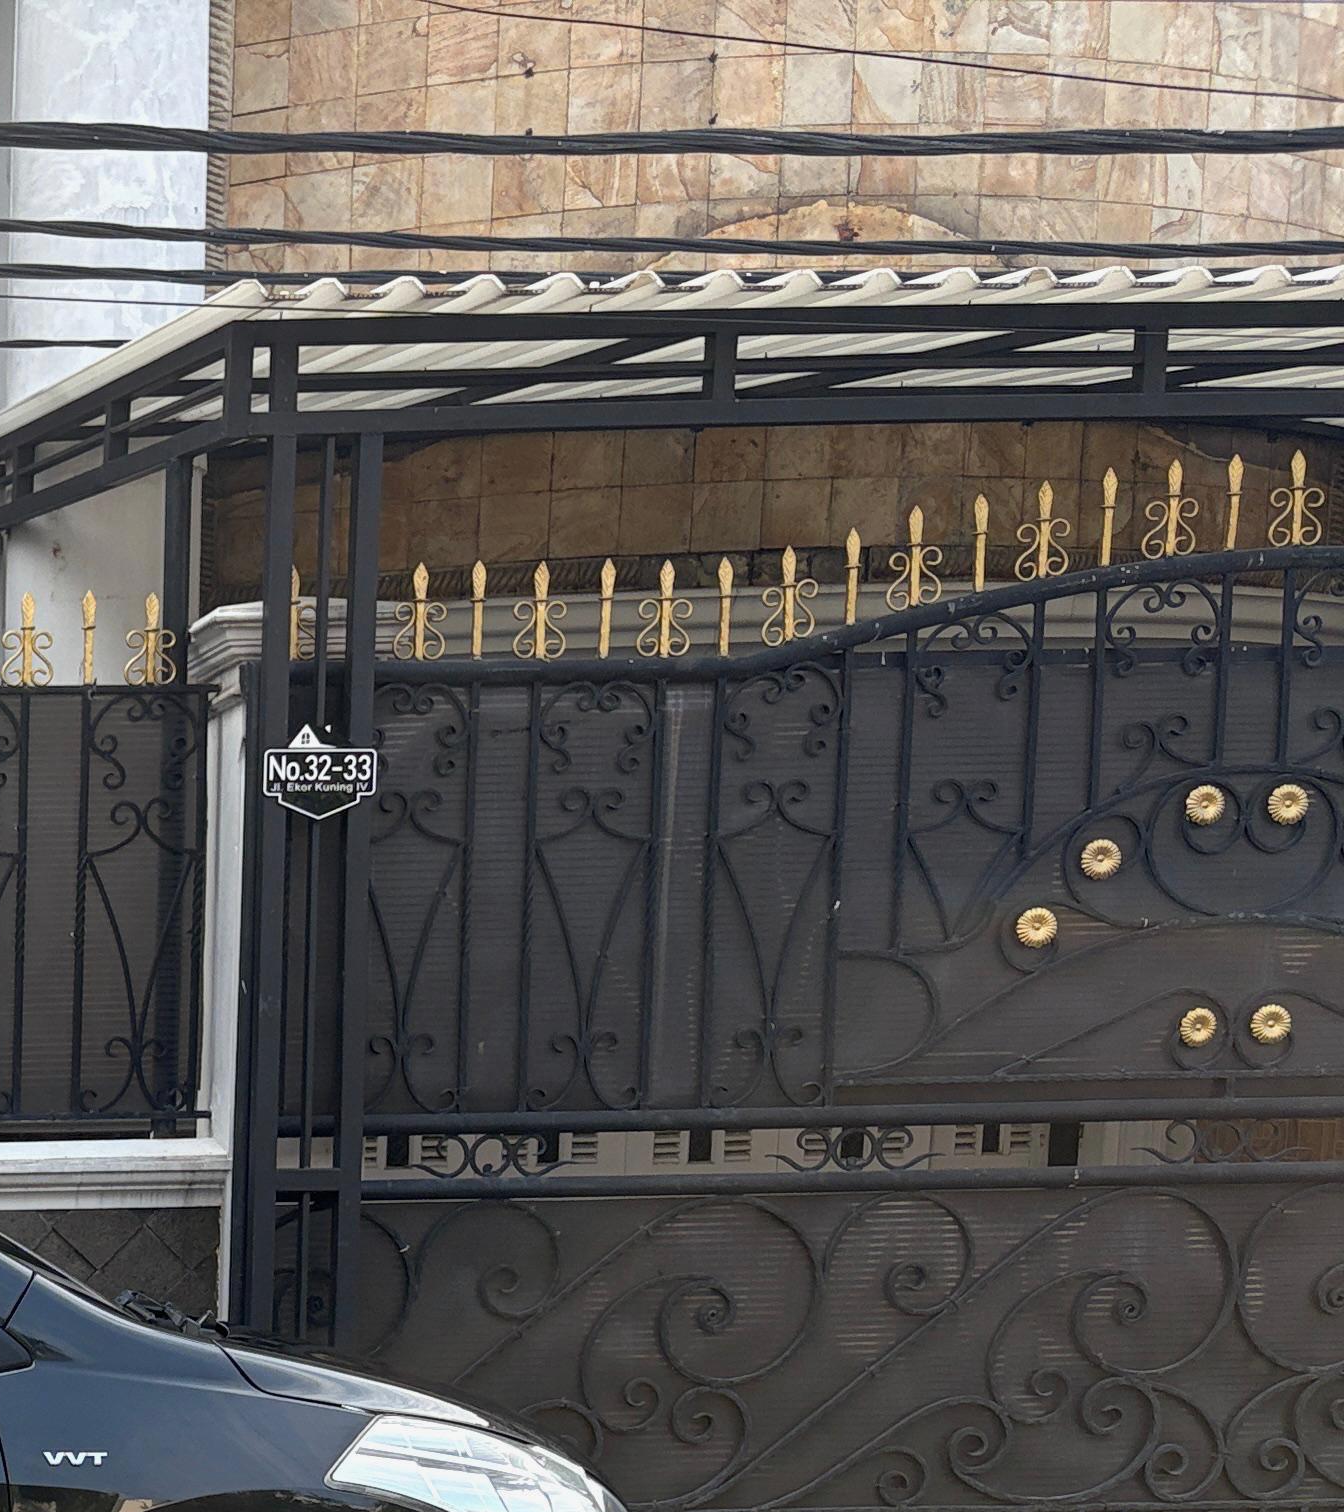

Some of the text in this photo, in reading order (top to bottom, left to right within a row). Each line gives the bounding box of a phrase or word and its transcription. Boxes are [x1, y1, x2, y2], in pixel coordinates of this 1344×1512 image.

[268, 754, 372, 782] No.32-33
[315, 782, 354, 794] Kuning
[356, 782, 369, 792] IV
[43, 1451, 108, 1466] VVT
